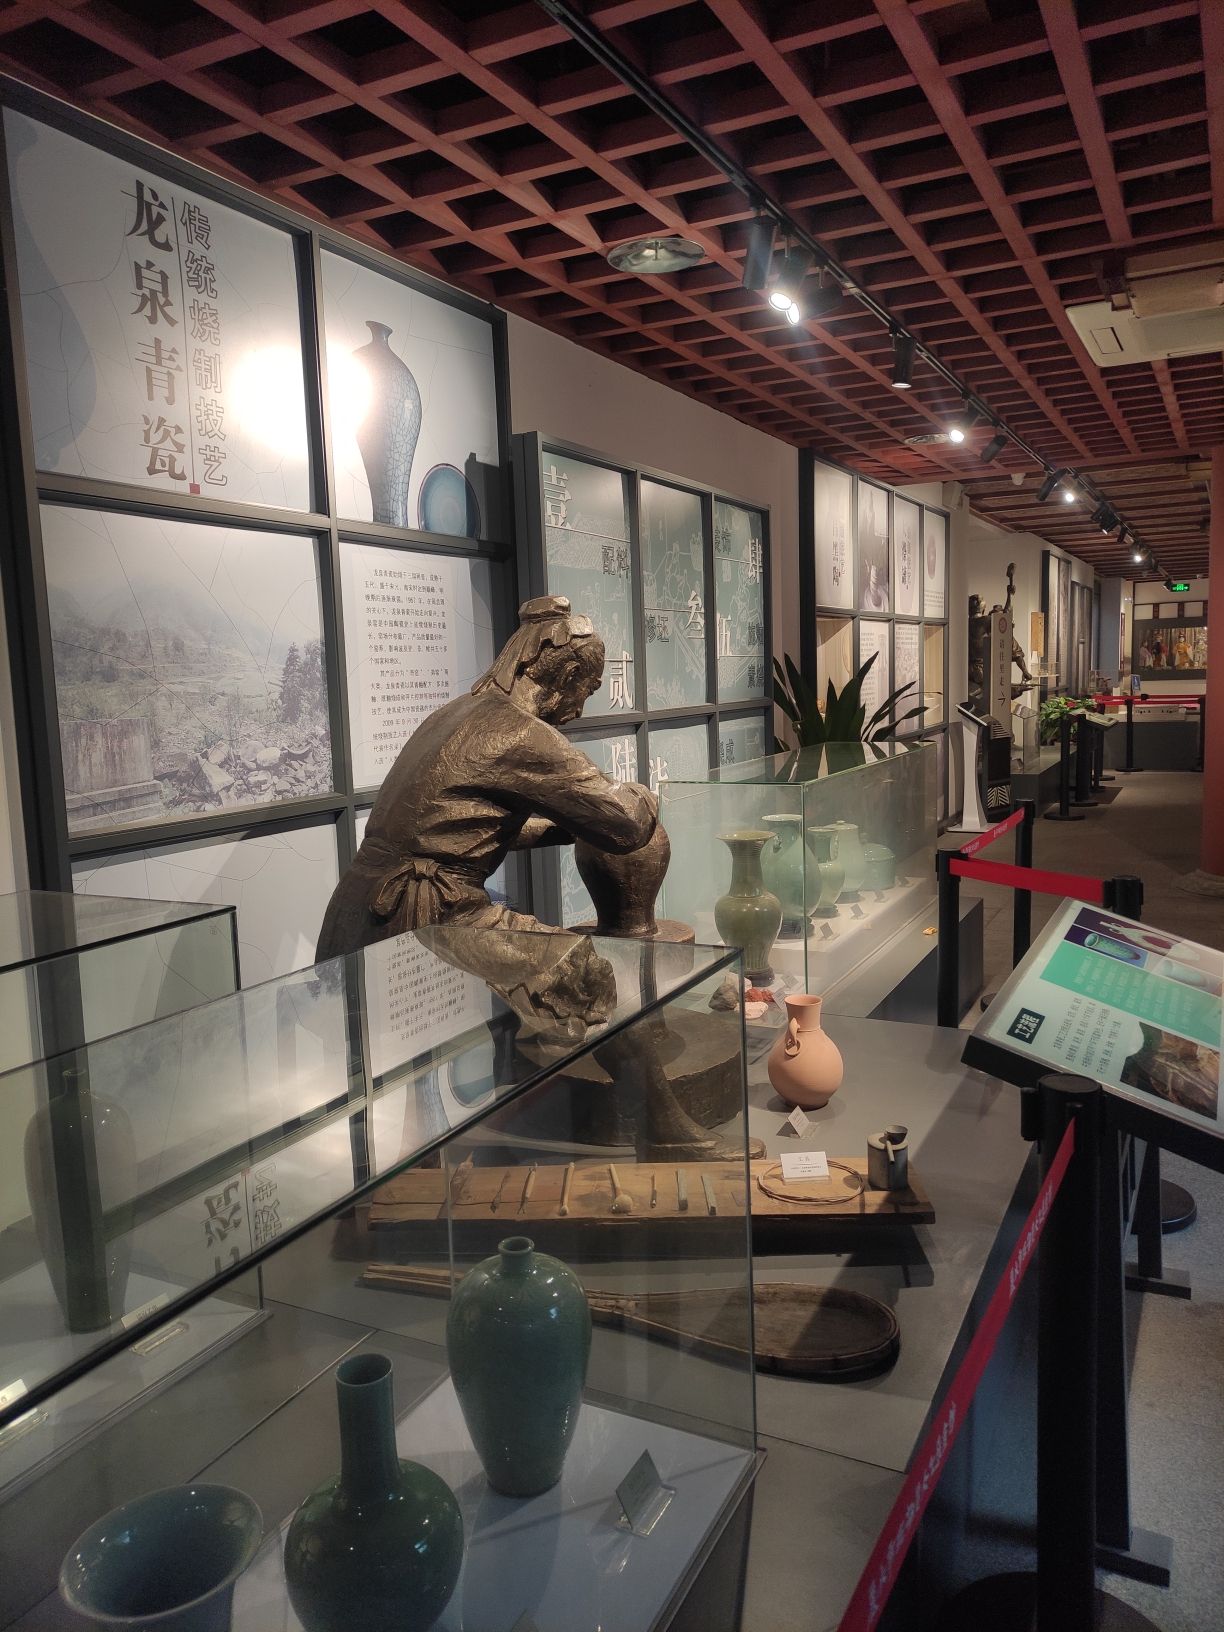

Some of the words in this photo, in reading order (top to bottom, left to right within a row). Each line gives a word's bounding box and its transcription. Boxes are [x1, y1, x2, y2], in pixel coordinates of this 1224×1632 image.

[121, 178, 188, 482] 龙泉青瓷
[180, 199, 229, 487] 传统烧制技艺
[543, 465, 572, 529] 壹
[601, 544, 631, 578] 配料
[686, 591, 705, 640] 叁
[607, 650, 634, 710] 贰
